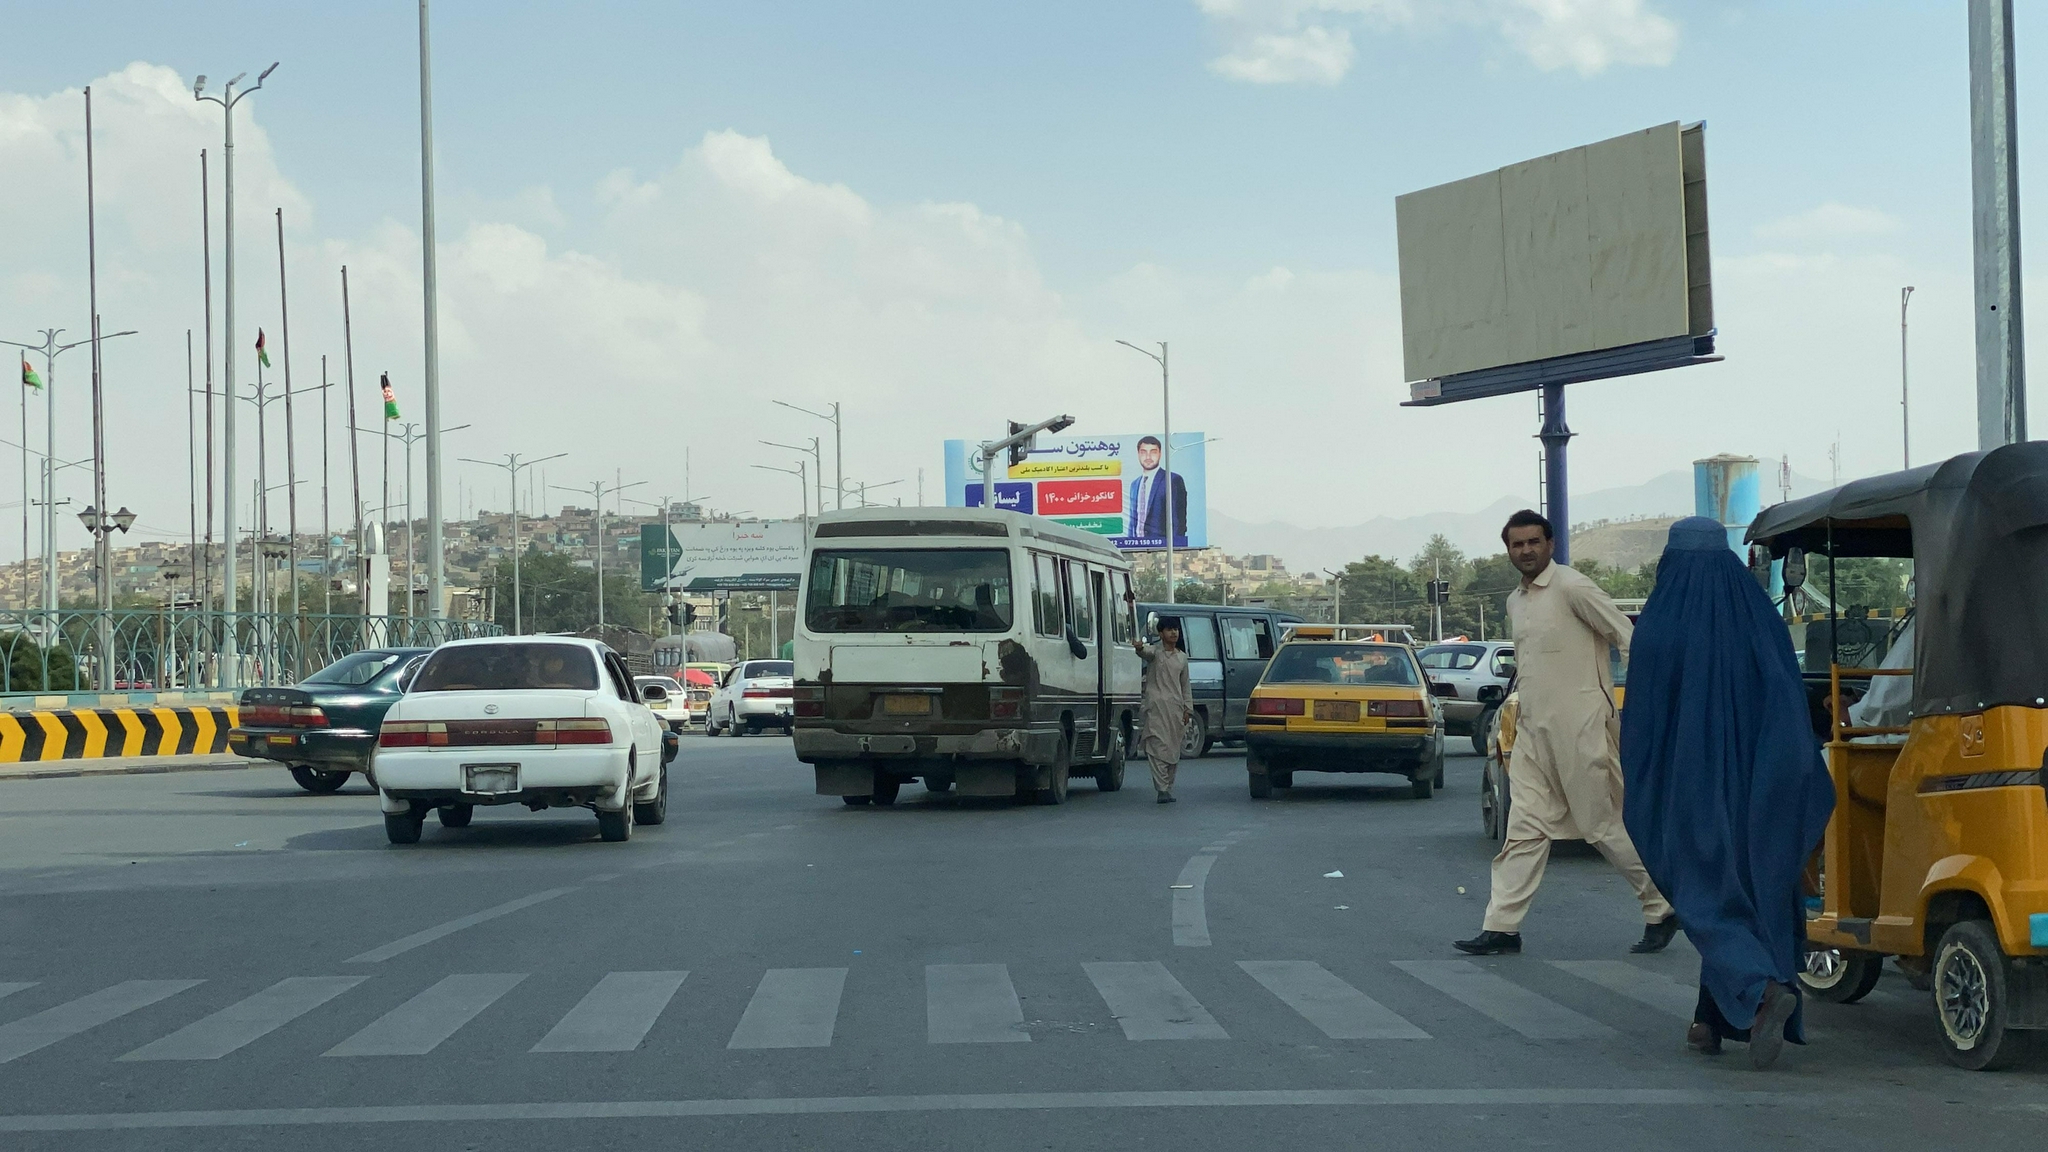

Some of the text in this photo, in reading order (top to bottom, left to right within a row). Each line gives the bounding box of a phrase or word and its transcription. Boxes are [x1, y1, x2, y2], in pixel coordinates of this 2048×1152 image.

[1066, 440, 1121, 457] پوهنتون
[978, 490, 1020, 508] لیسان
[1044, 491, 1115, 504] کانکور خزانی ۱۴۰۰
